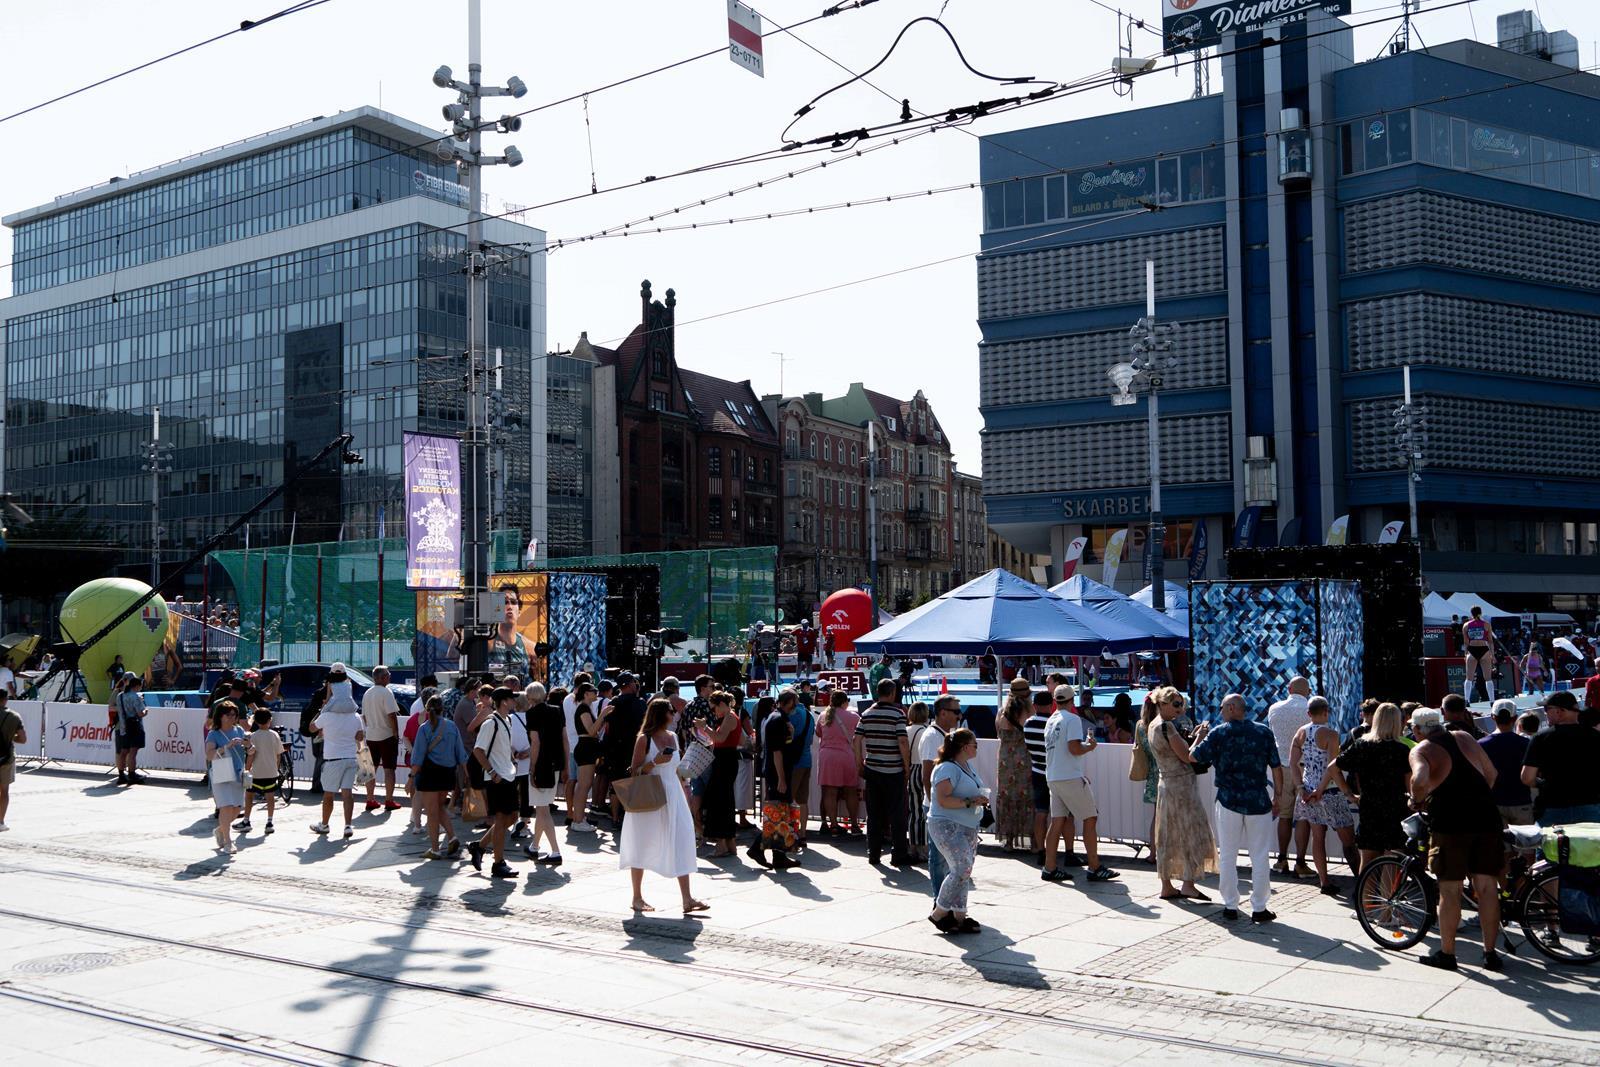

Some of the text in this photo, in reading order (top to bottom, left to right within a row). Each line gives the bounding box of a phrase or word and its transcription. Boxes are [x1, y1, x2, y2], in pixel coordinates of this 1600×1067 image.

[730, 43, 760, 69] 23-07T1
[426, 175, 444, 191] FIBA
[1072, 202, 1101, 214] BILARD
[1063, 496, 1152, 518] SKARBEK
[1447, 667, 1466, 676] DUPL
[70, 722, 113, 742] polanik
[154, 739, 193, 754] OMEGA
